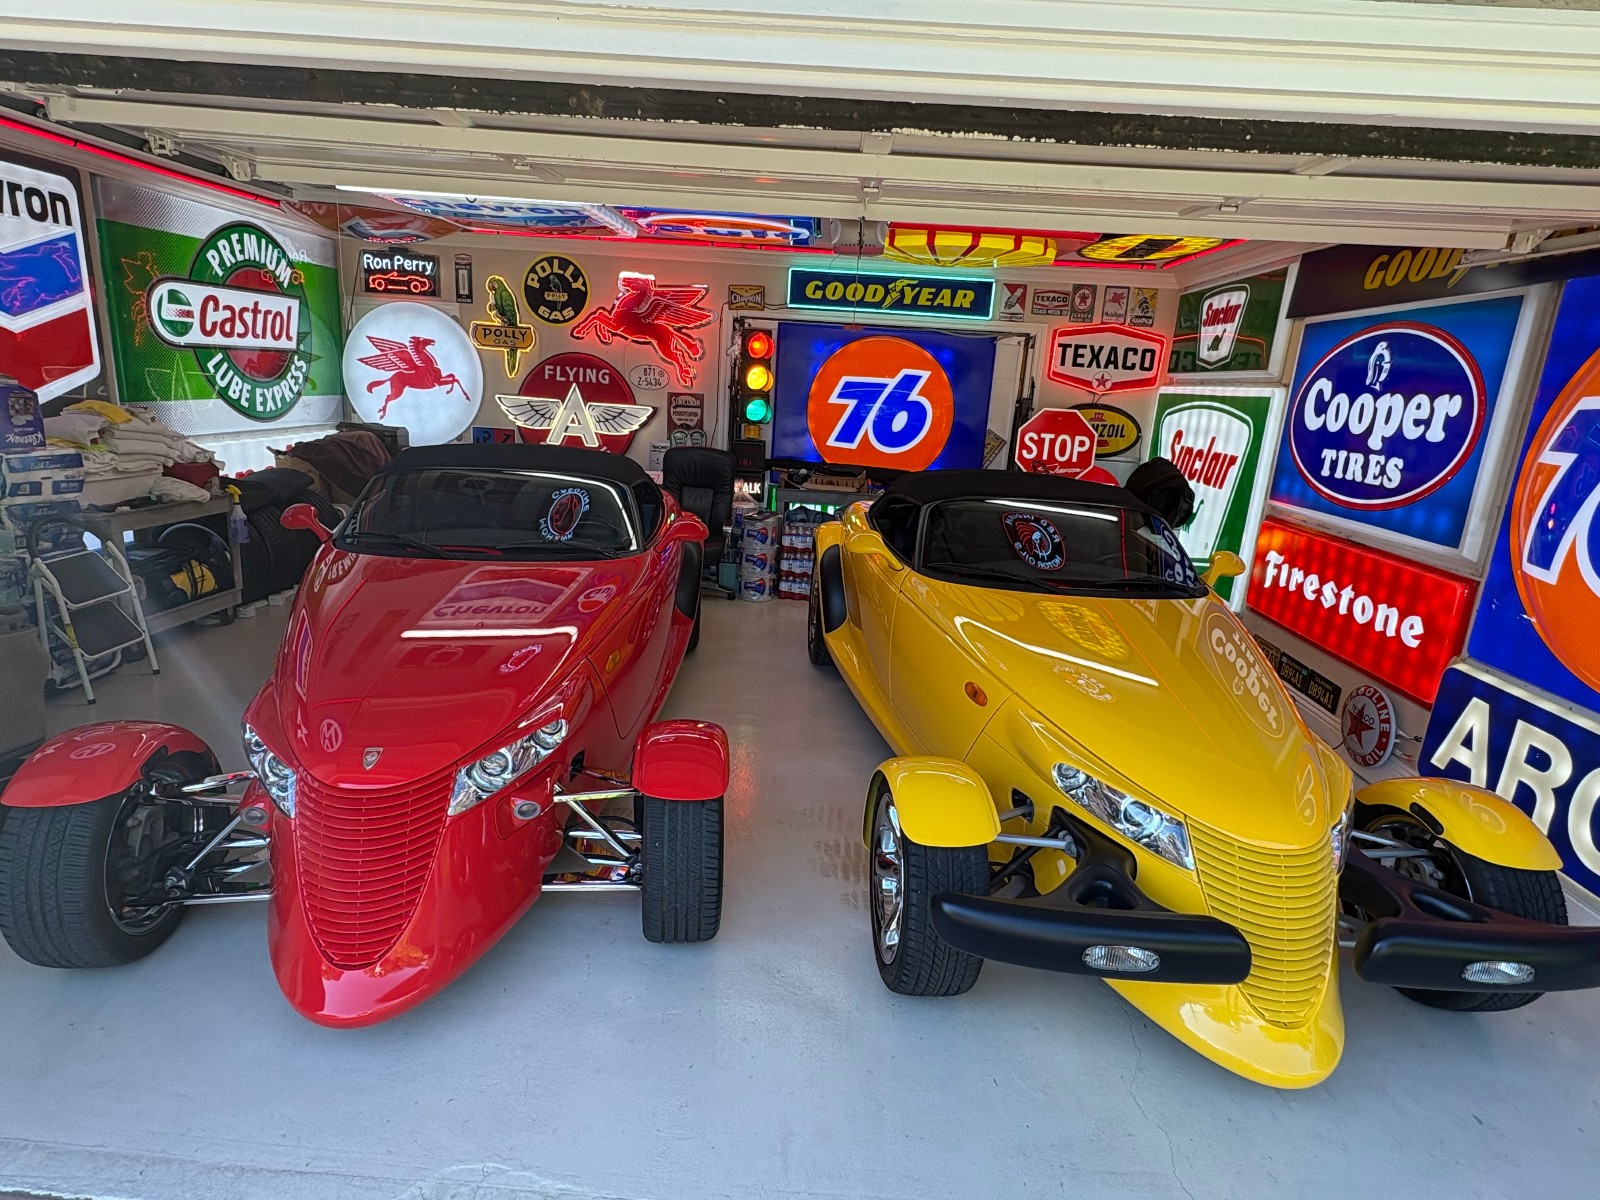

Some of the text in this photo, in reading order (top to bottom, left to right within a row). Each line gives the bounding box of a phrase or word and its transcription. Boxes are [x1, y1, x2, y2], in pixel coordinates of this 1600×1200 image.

[0, 180, 73, 227] ron
[207, 232, 291, 289] PREMIUM
[363, 253, 434, 276] Ron Perry
[527, 258, 586, 293] POLLY
[199, 295, 293, 342] Castrol
[538, 306, 575, 321] GAS
[1203, 299, 1242, 328] Sinclair
[483, 328, 528, 343] POLLY
[493, 338, 518, 346] GAS
[643, 367, 656, 377] 871
[1057, 343, 1157, 372] TEXACO
[206, 353, 308, 413] LUBE EXPRESS
[544, 365, 611, 384] FLYING
[546, 383, 600, 448] A
[826, 368, 933, 454] 76
[1304, 377, 1463, 451] Cooper
[5, 430, 45, 446] Kleenex
[1090, 423, 1127, 439] NZOIL
[1021, 432, 1091, 463] STOP
[1170, 429, 1239, 490] Sinclair
[1320, 448, 1404, 489] TIRES
[1263, 550, 1425, 648] Firestone
[1366, 748, 1384, 764] OIL
